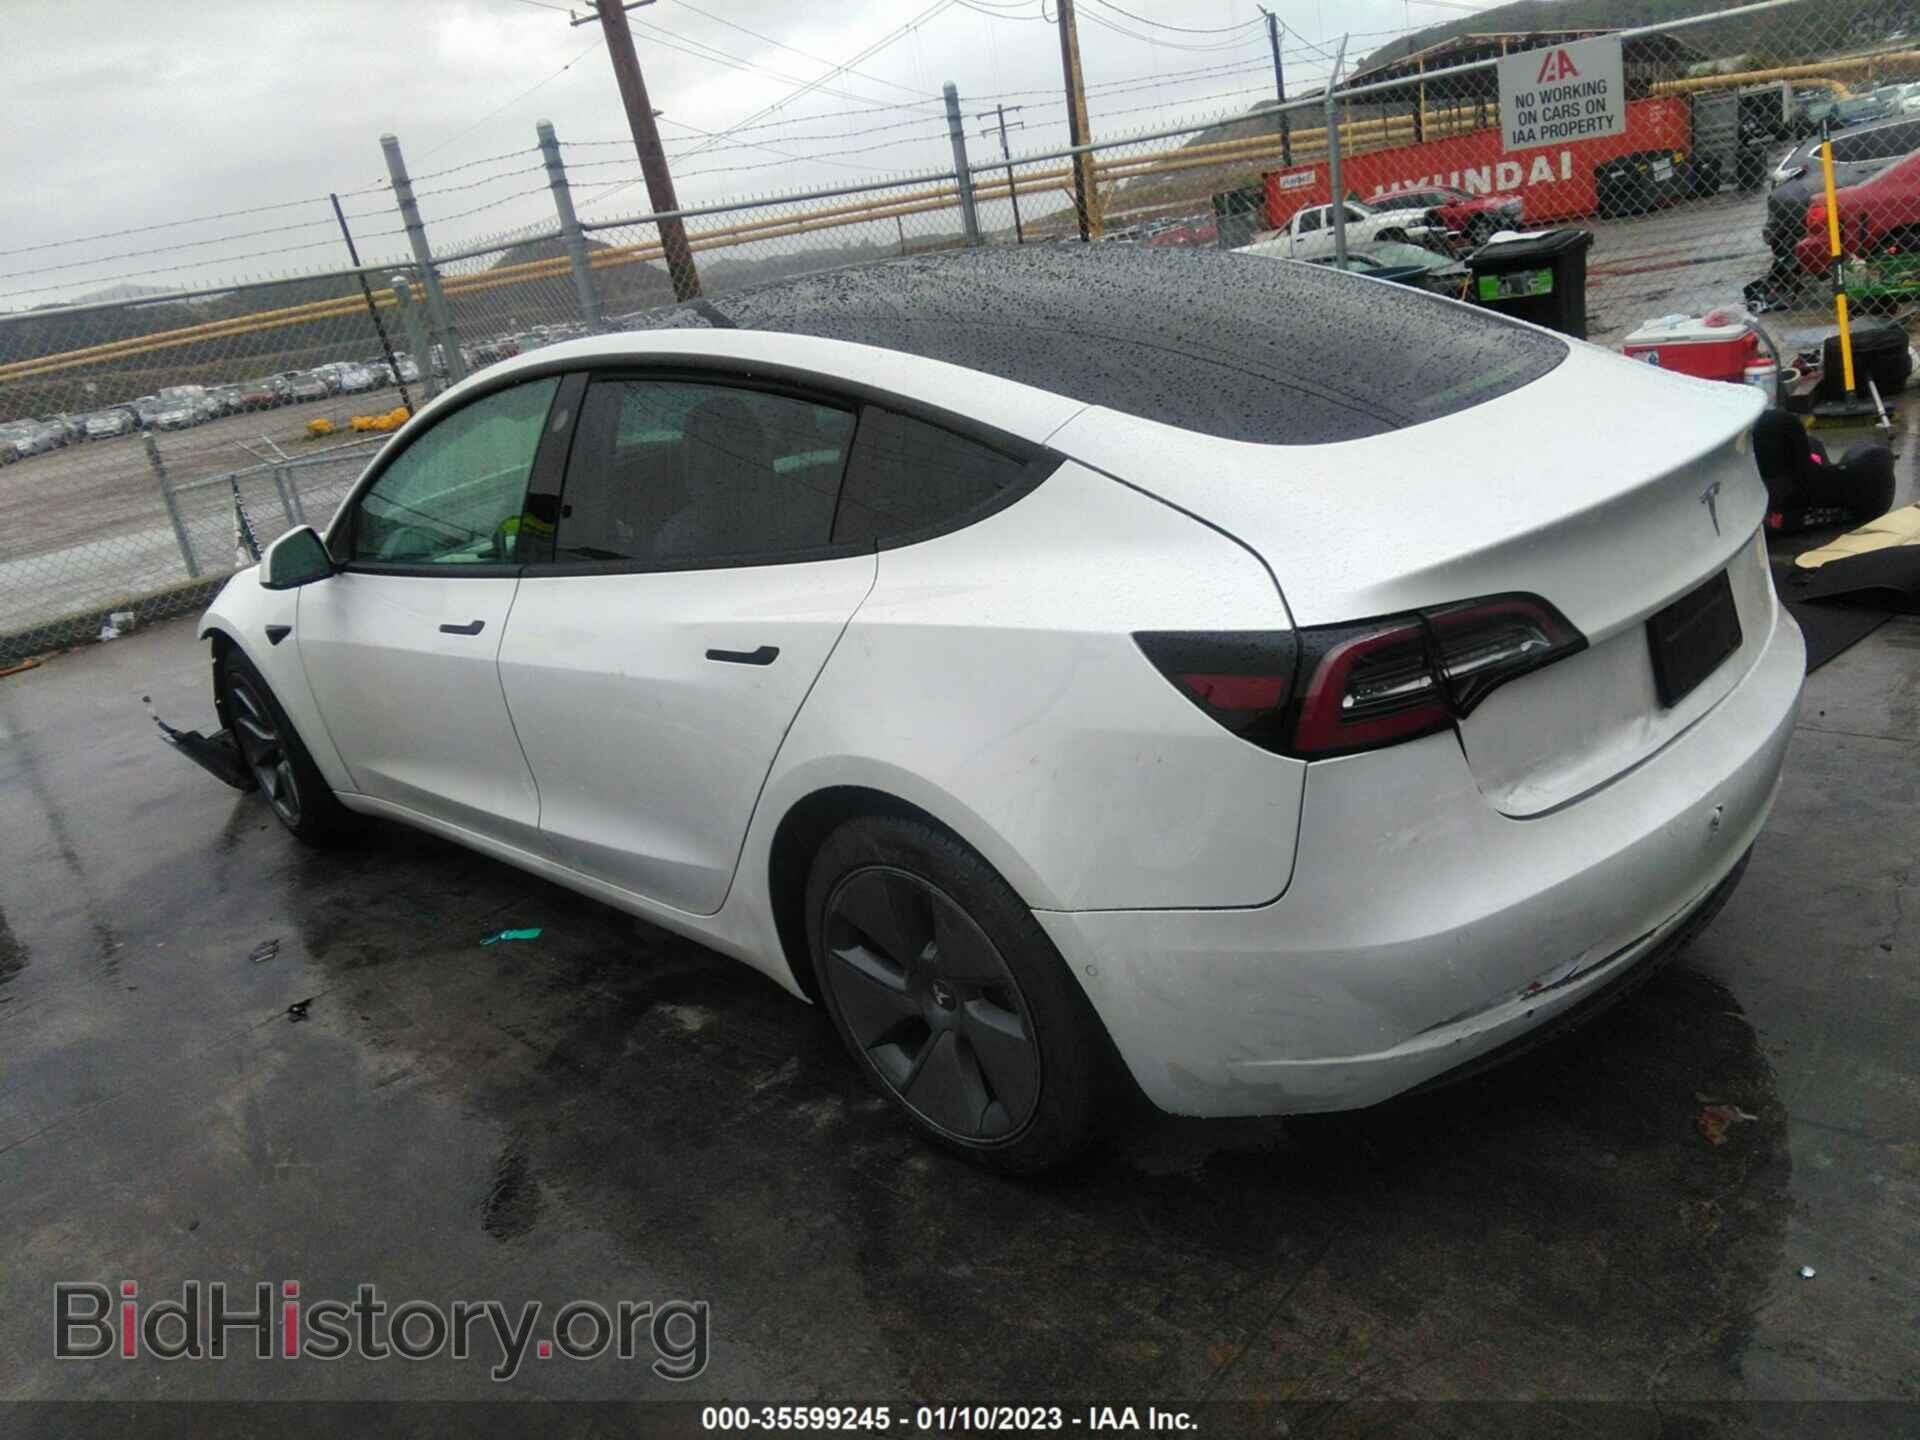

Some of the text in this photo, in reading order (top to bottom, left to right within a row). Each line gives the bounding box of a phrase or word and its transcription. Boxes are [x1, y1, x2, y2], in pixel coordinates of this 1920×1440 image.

[1515, 79, 1607, 108] NO WORKING
[1518, 97, 1606, 126] ON CARS ON
[1512, 114, 1614, 144] IAA PROPERTY
